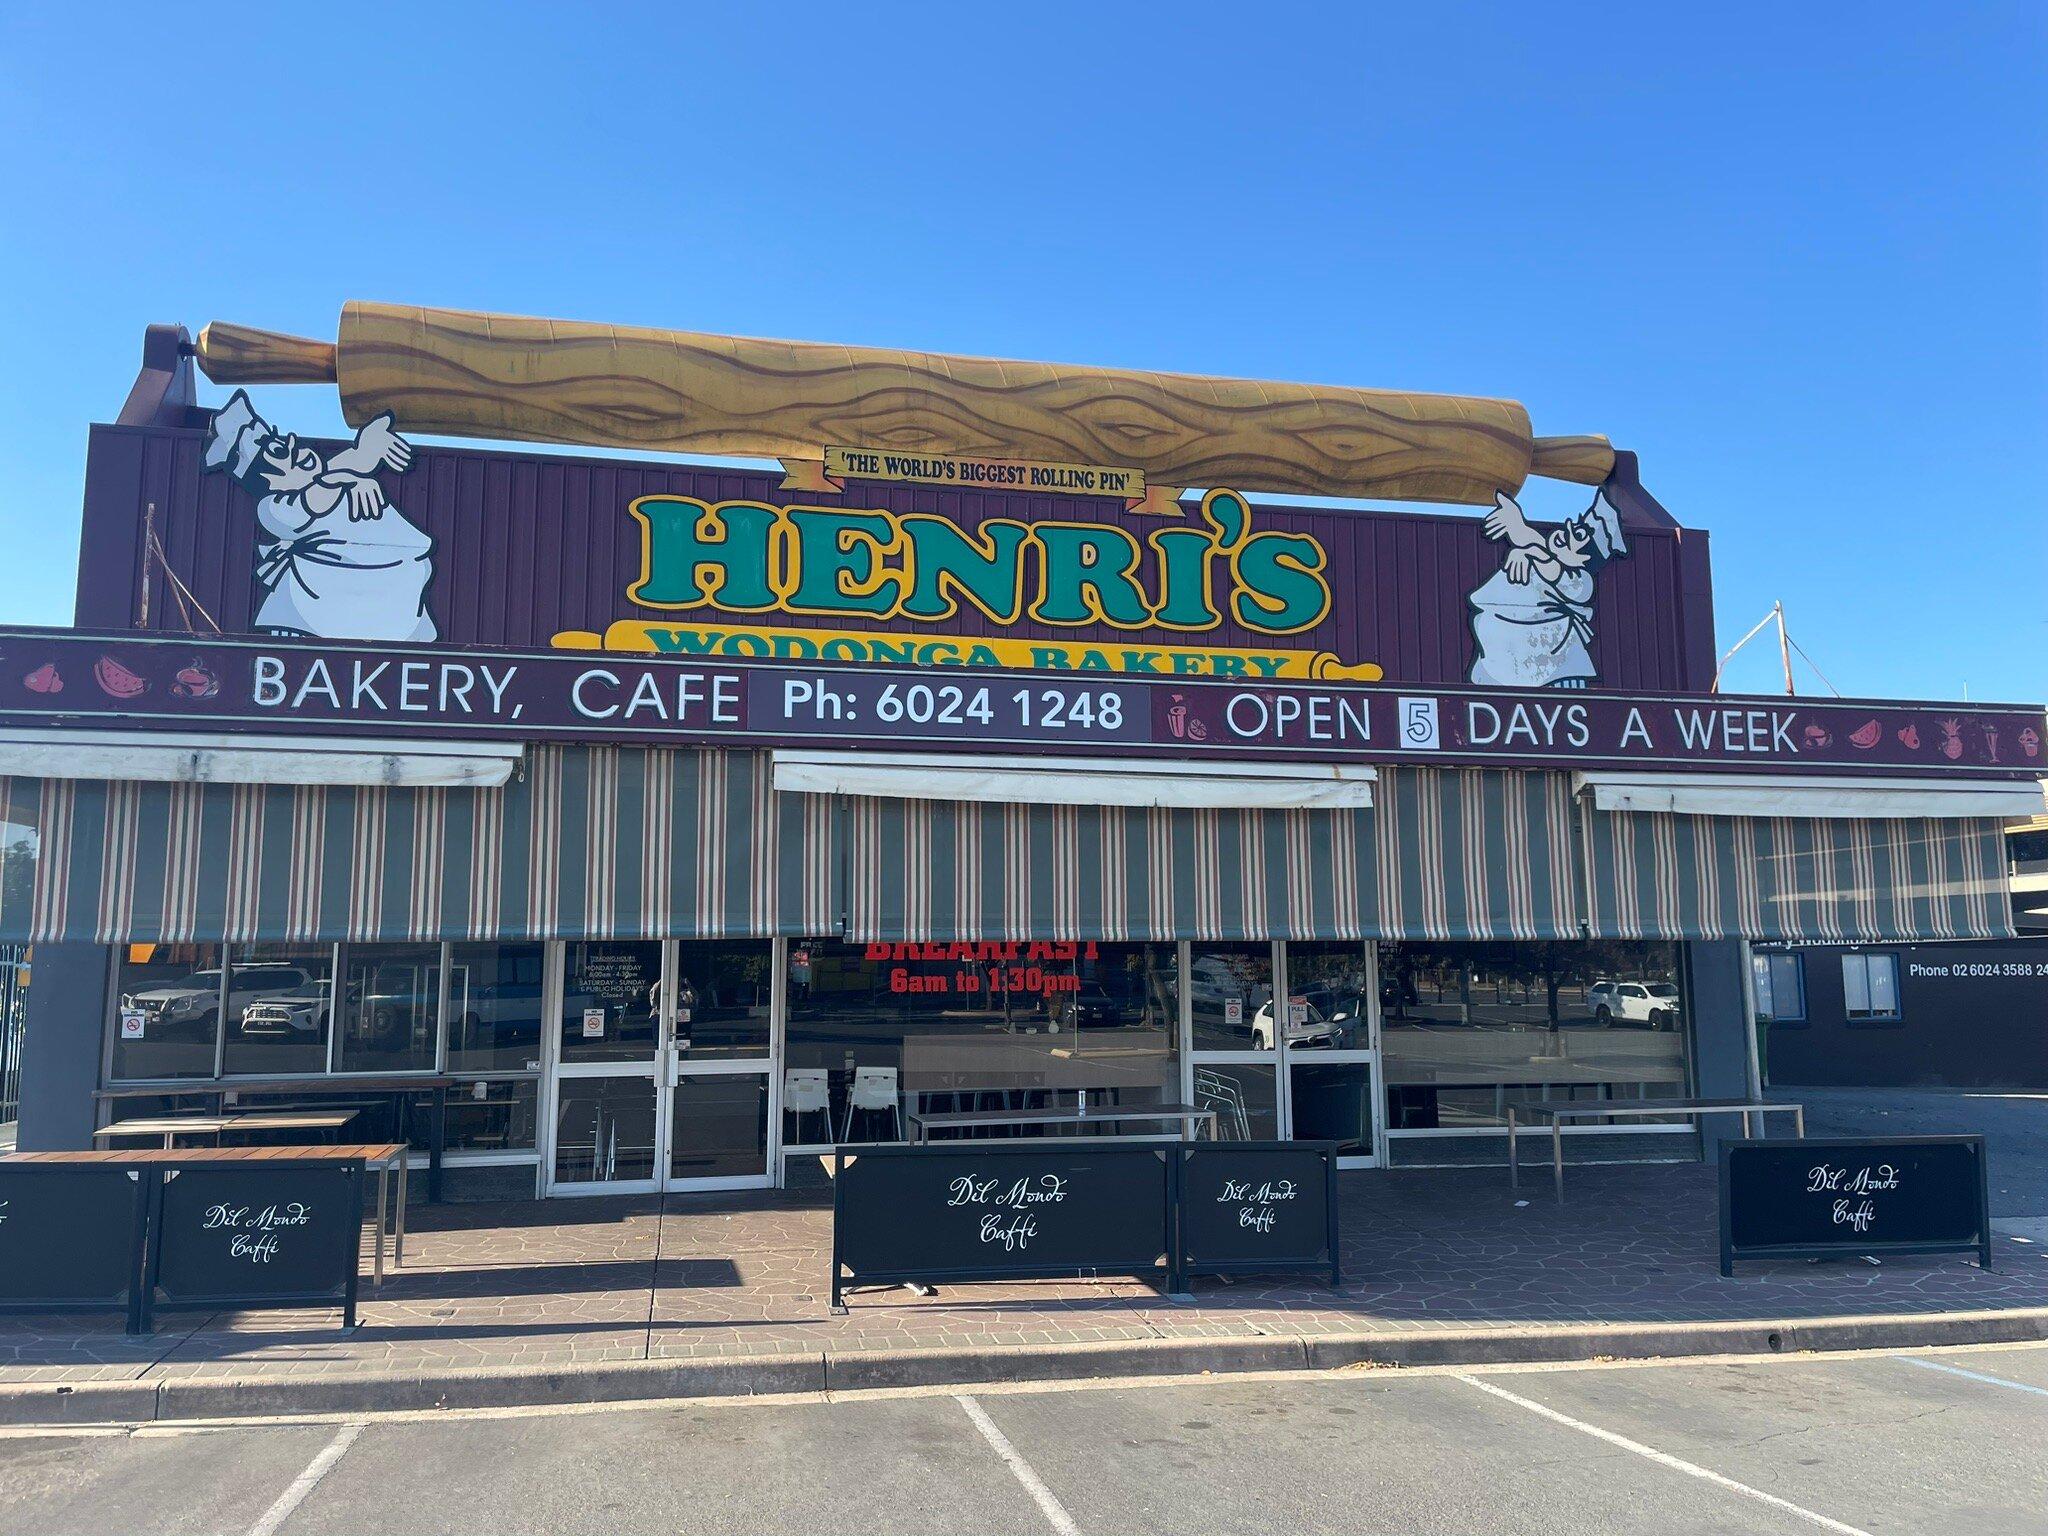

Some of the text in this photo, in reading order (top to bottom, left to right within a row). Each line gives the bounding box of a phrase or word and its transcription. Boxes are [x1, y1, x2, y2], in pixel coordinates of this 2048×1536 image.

[841, 451, 1130, 491] 'THE WORLD'S BIGGEST ROLLING PIN'
[629, 488, 1331, 635] HENRI'S
[643, 628, 1290, 678] WODONGA BAKERY
[252, 655, 740, 722] BAKERY, CAFE
[783, 678, 1124, 731] Ph: 6024 1248
[1226, 693, 1799, 754] OPEN 5 DAYS A WEEK
[890, 967, 1081, 997] 6am to 1:30pm
[1909, 963, 1949, 977] Phone
[1952, 963, 1968, 977] 02
[1969, 963, 2001, 977] 6024
[2002, 963, 2033, 977] 3588
[995, 1174, 1067, 1209] Mondo
[1248, 1180, 1297, 1204] Mondo
[1843, 1164, 1900, 1195] Mondo
[245, 1202, 311, 1231] Mondo
